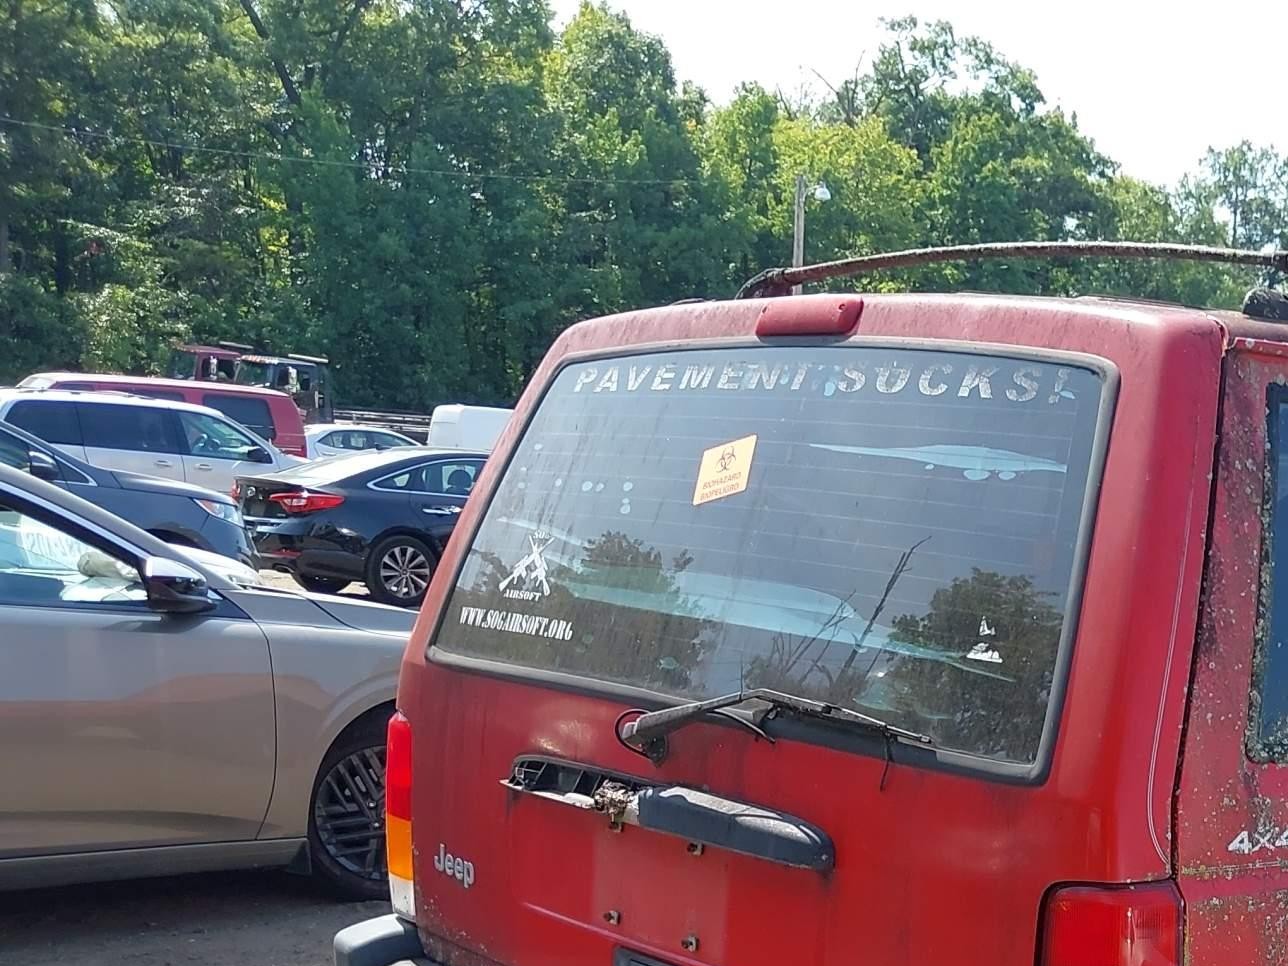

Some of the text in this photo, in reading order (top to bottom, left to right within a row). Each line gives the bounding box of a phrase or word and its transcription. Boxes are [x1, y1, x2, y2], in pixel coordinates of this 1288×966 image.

[503, 589, 542, 602] AIRSOFT
[459, 606, 574, 641] WWW.SOGAIRSOFT.ORG
[433, 843, 475, 889] Jeep
